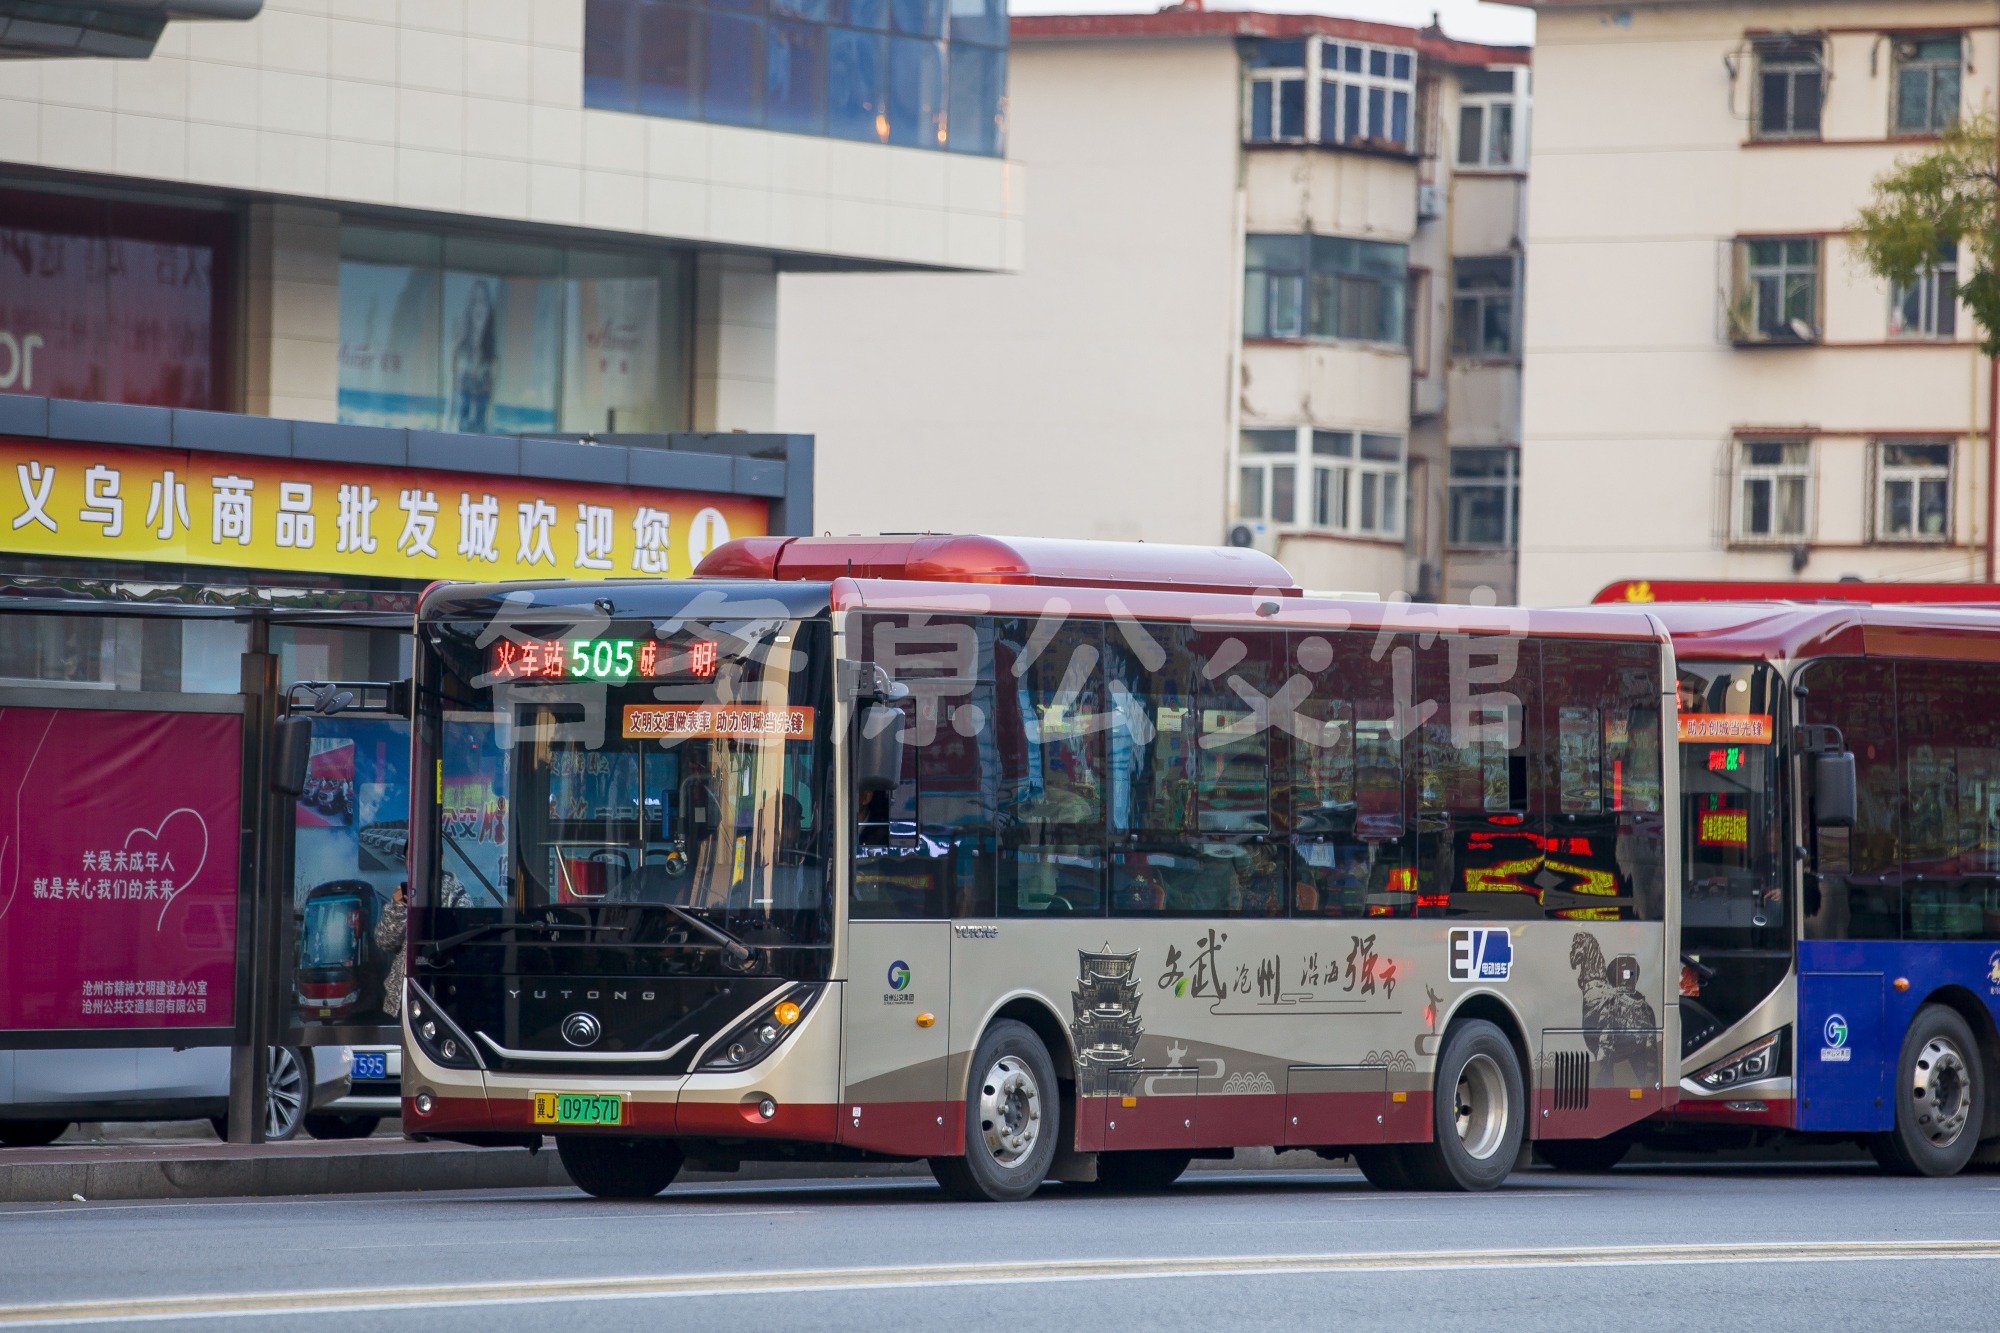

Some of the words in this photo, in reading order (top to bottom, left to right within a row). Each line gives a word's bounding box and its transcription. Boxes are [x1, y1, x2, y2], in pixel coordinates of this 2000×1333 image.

[12, 461, 671, 574] 义乌小商品批发城欢迎您
[494, 641, 564, 677] 火车站
[571, 640, 634, 677] 505
[692, 641, 717, 677] 明
[630, 711, 711, 734] 文明交通做表率
[716, 711, 804, 734] 助力创城当先锋
[83, 850, 175, 872] 关爱未成年人
[33, 877, 175, 900] 就是关心我们的未来
[82, 980, 208, 996] 沧州市精神文明建设办公室
[508, 989, 655, 1001] YUTONG
[82, 999, 207, 1014] 沧州公共交通集团有限公司
